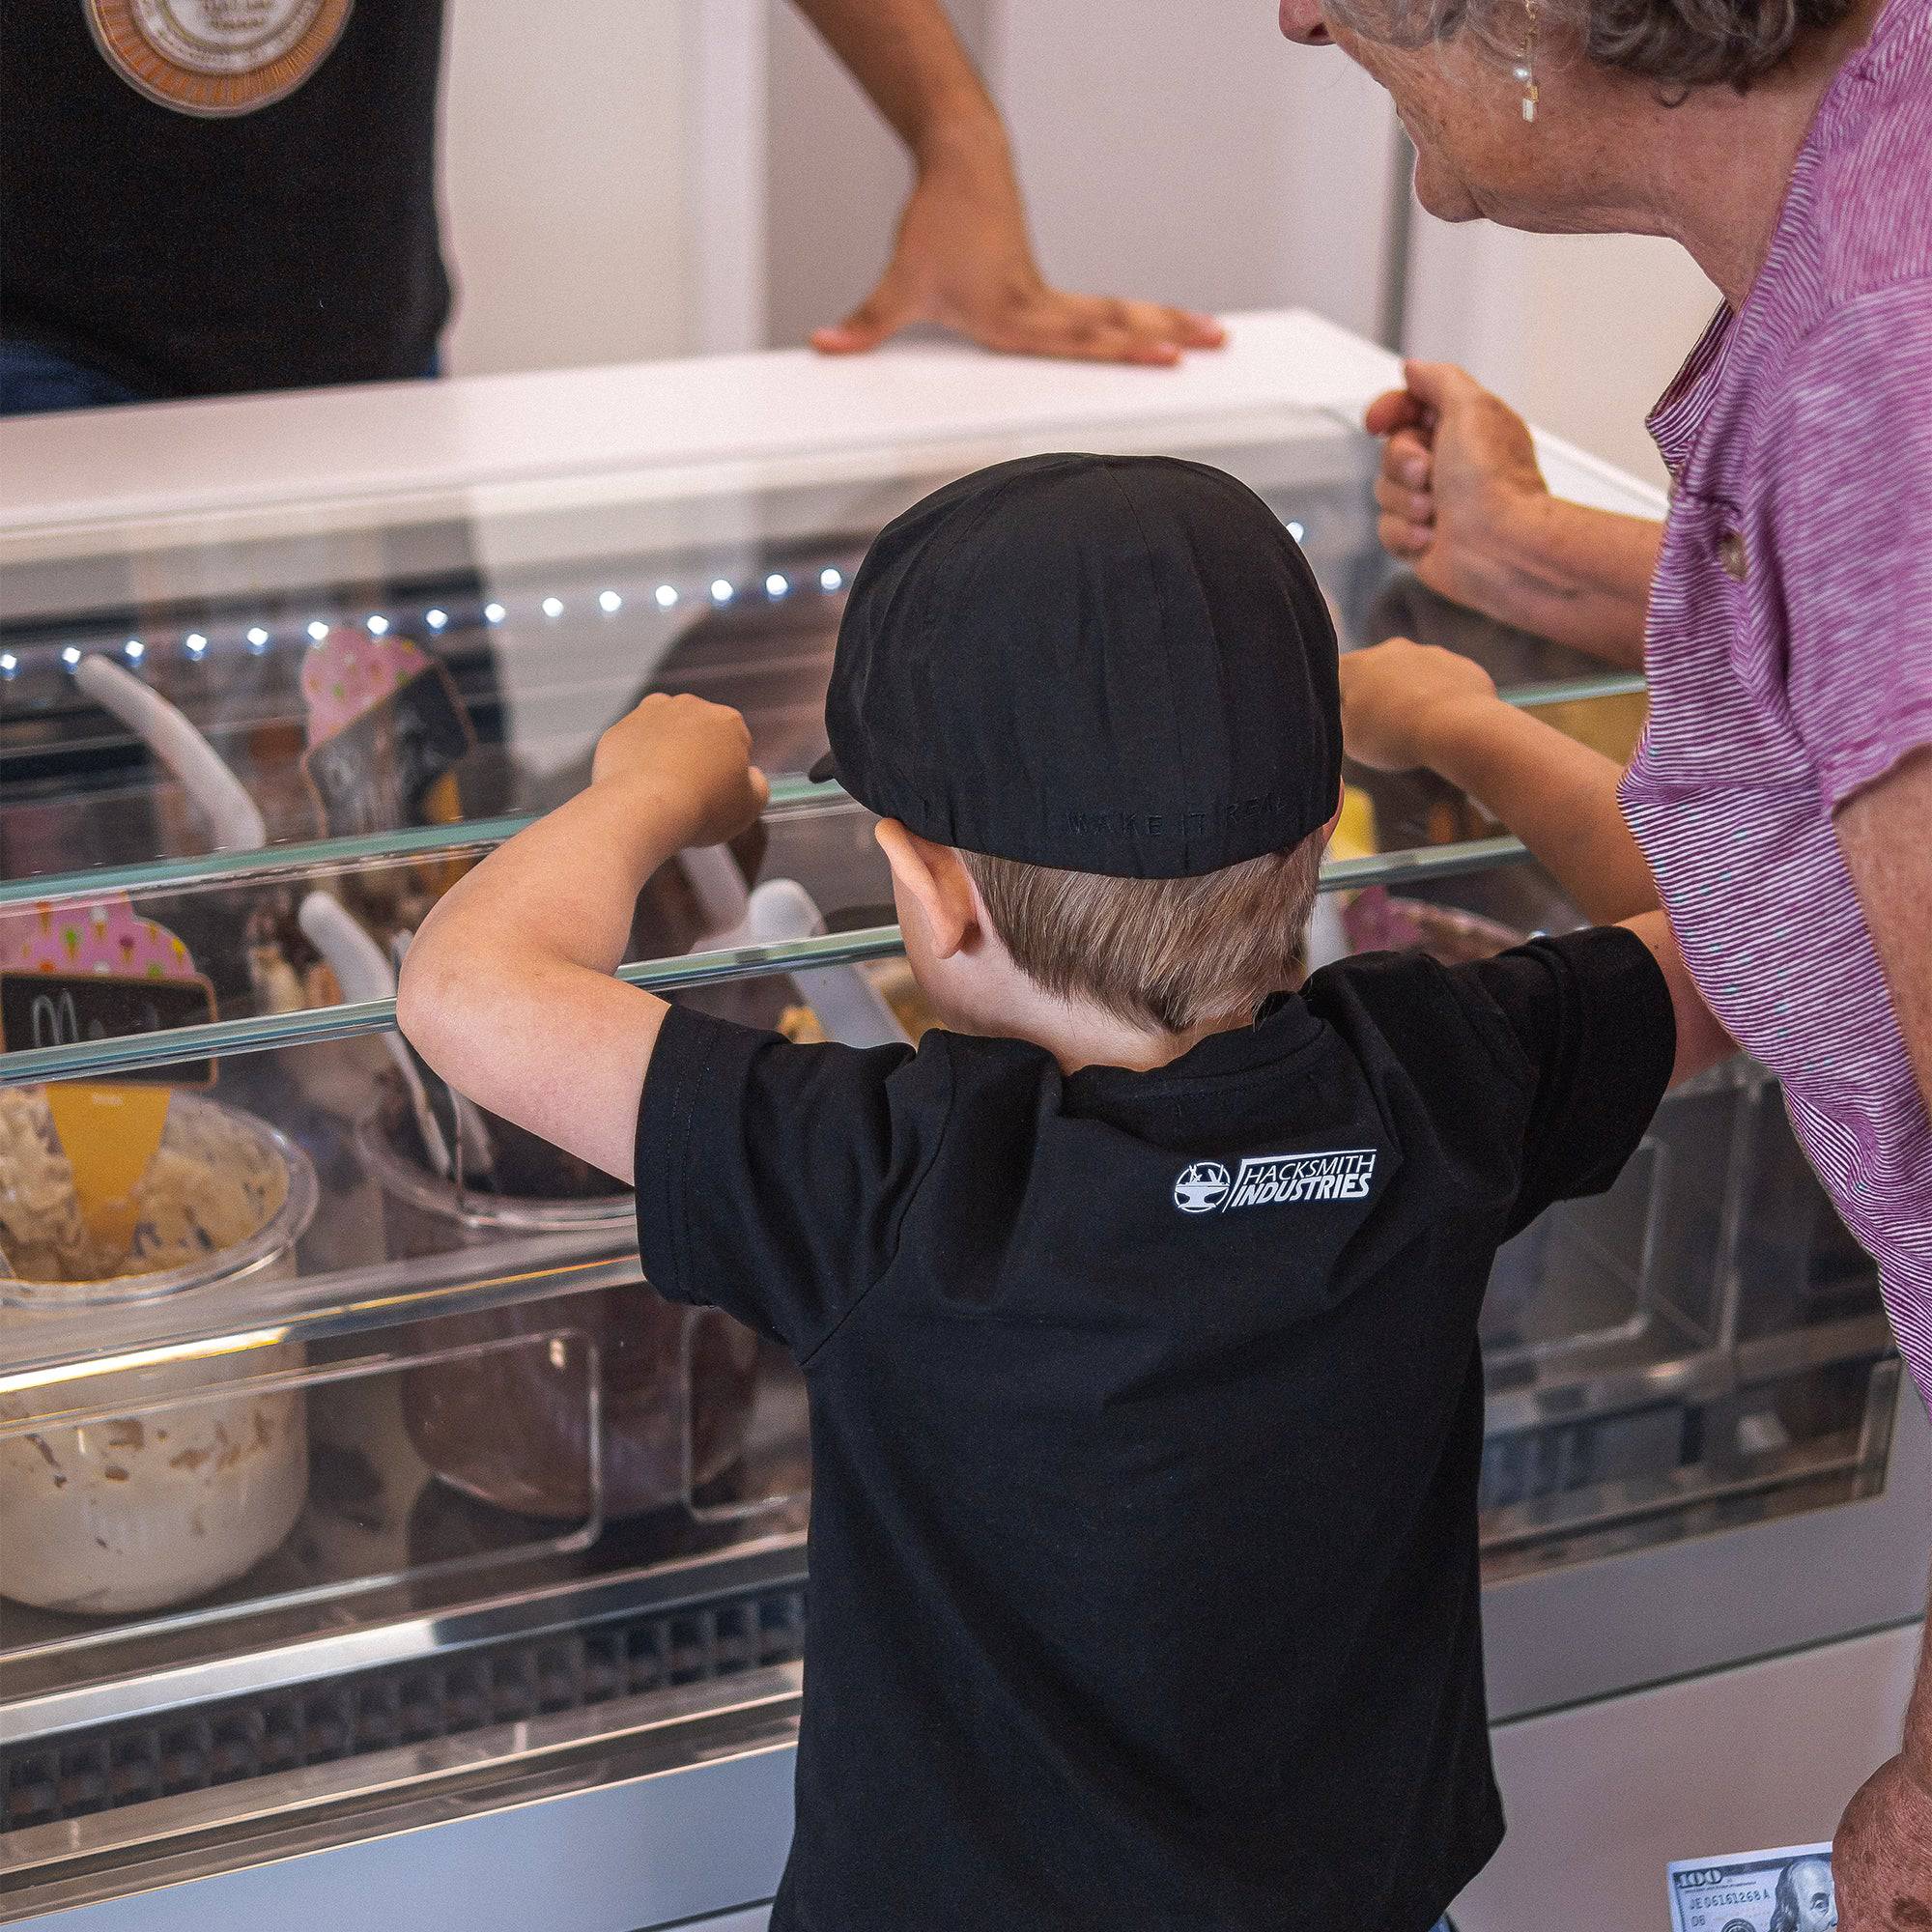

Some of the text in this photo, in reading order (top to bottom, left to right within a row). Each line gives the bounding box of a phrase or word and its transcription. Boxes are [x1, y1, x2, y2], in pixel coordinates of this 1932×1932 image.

[1065, 810, 1163, 838] MAKE
[1180, 811, 1207, 838] IT
[1243, 1154, 1377, 1186] HACKSMITH
[1231, 1173, 1373, 1208] INDUSTRIES
[1678, 1868, 1722, 1889] 100
